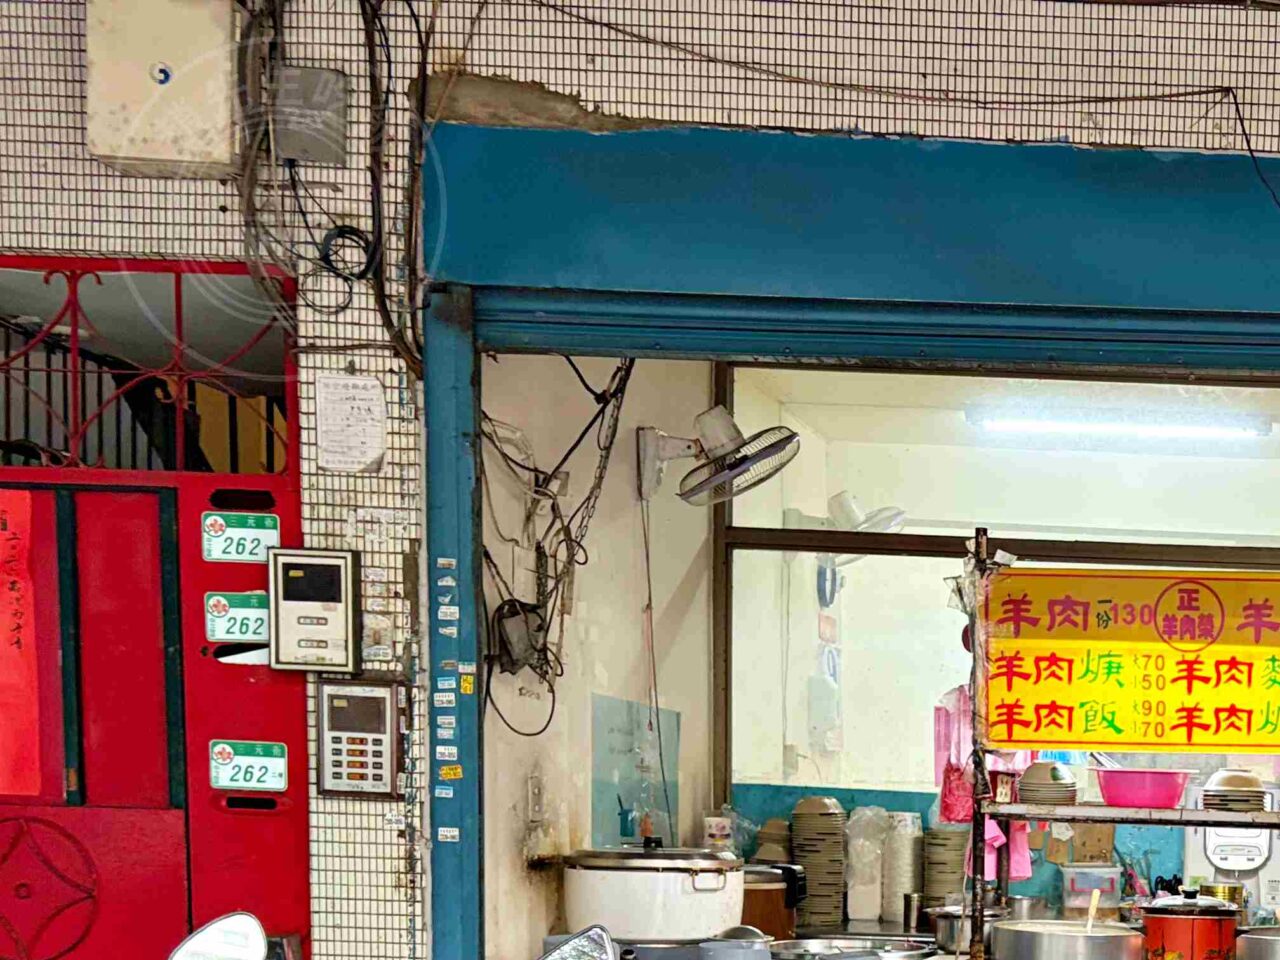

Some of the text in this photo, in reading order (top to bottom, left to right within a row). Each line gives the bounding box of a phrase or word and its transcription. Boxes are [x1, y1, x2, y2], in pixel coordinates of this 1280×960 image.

[222, 536, 261, 556] 262
[1177, 588, 1200, 611] 正
[225, 616, 265, 635] 262
[997, 593, 1091, 638] 羊肉
[1111, 603, 1154, 625] 130
[990, 698, 1125, 740] 羊肉飯
[229, 765, 269, 783] 262
